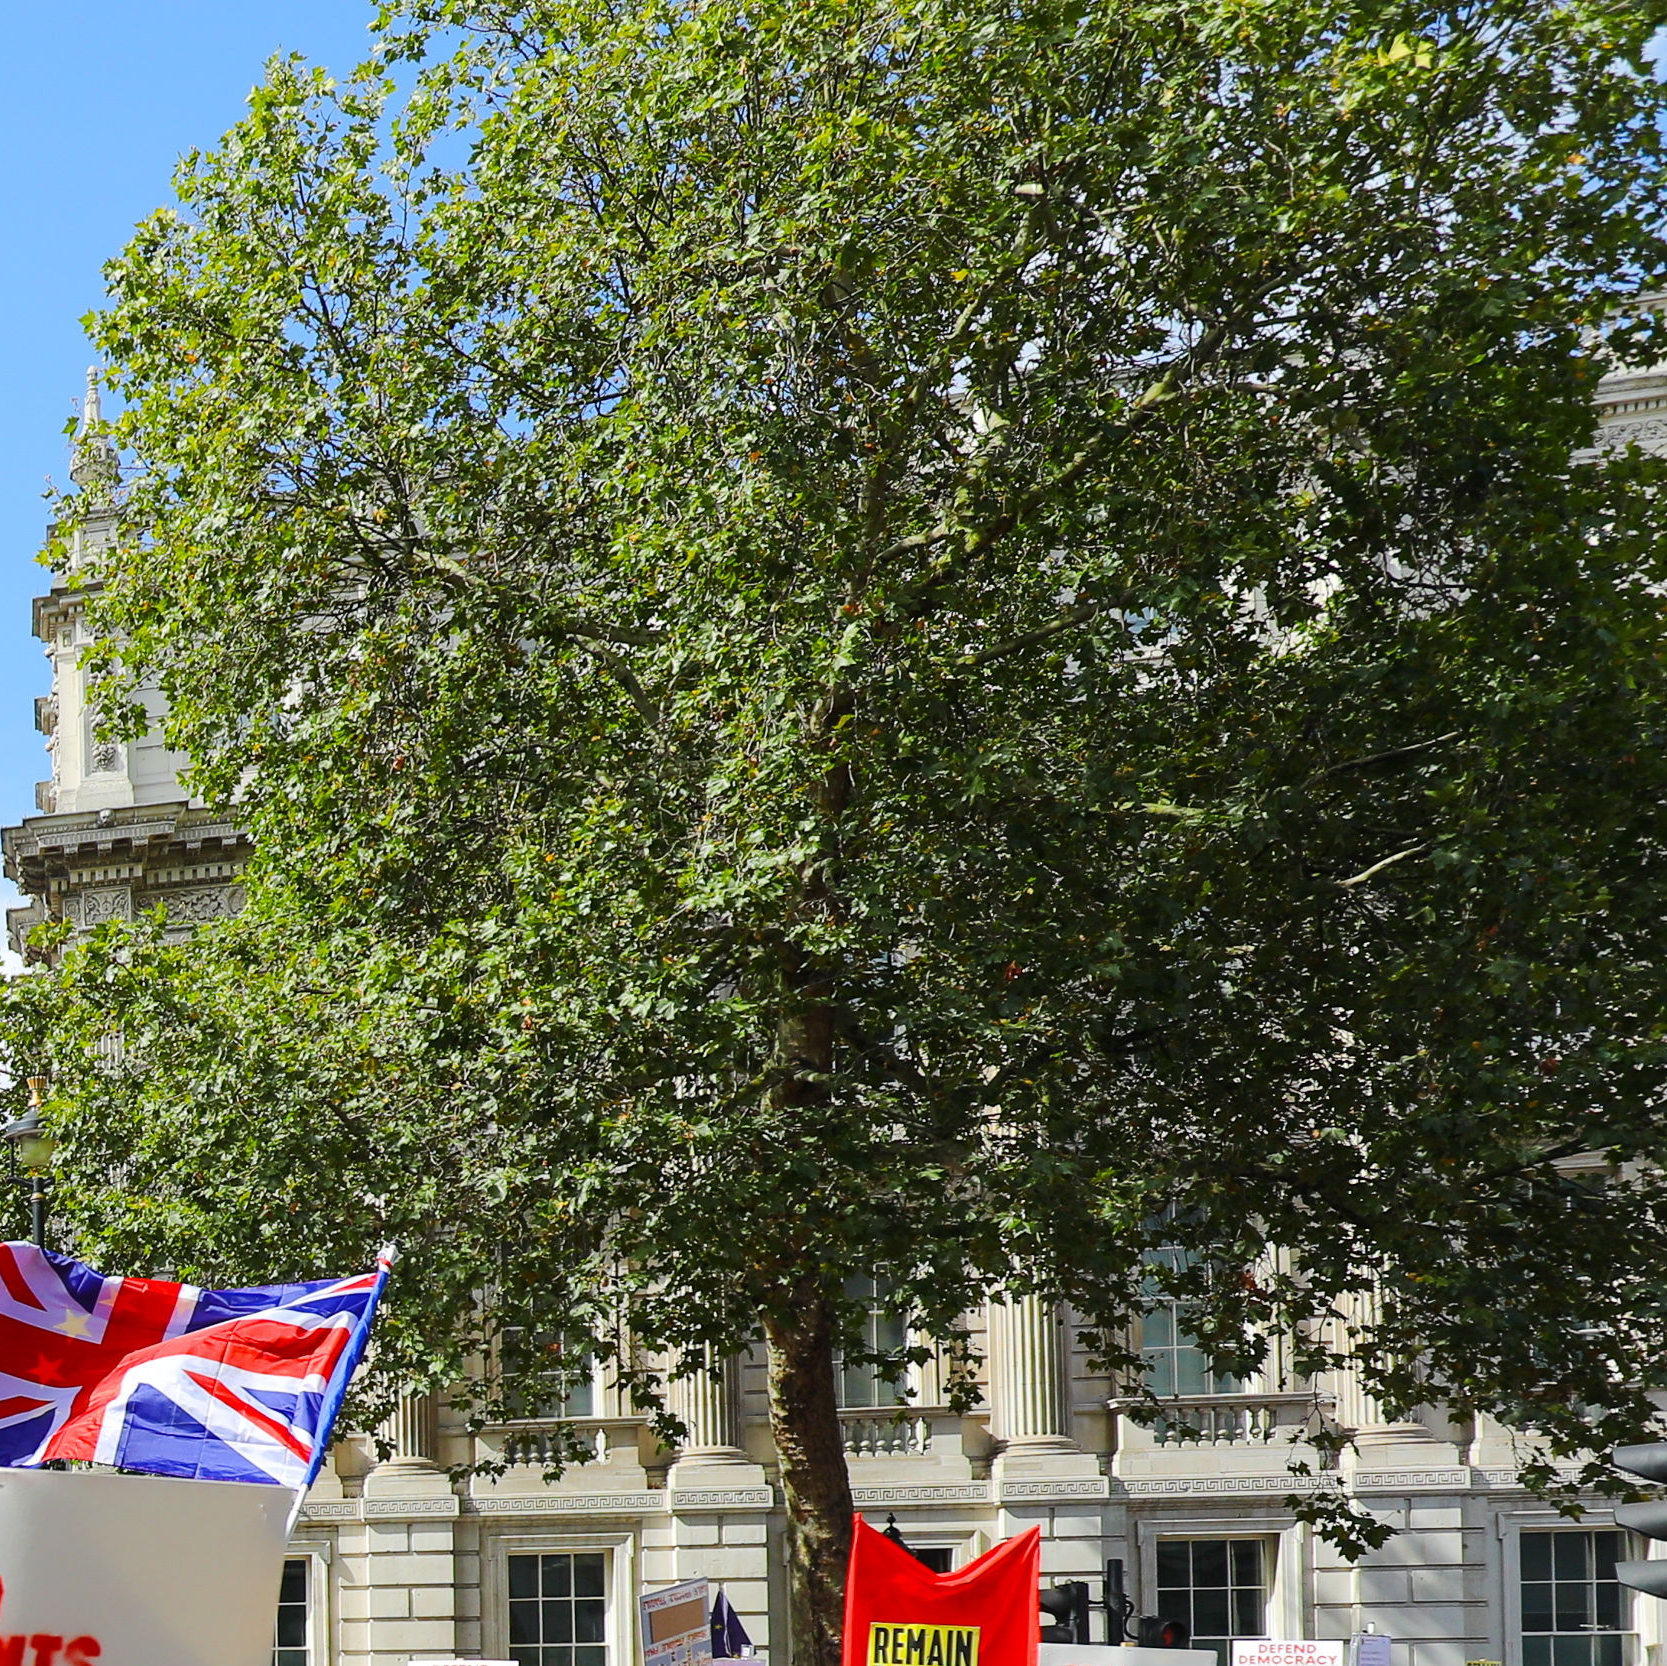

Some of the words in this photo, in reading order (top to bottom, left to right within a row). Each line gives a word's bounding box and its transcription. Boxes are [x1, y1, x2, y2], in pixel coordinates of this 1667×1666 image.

[874, 1627, 973, 1666] REMAIN
[1258, 1644, 1317, 1655] DEFEND
[1238, 1653, 1337, 1665] DEMOCRACY
